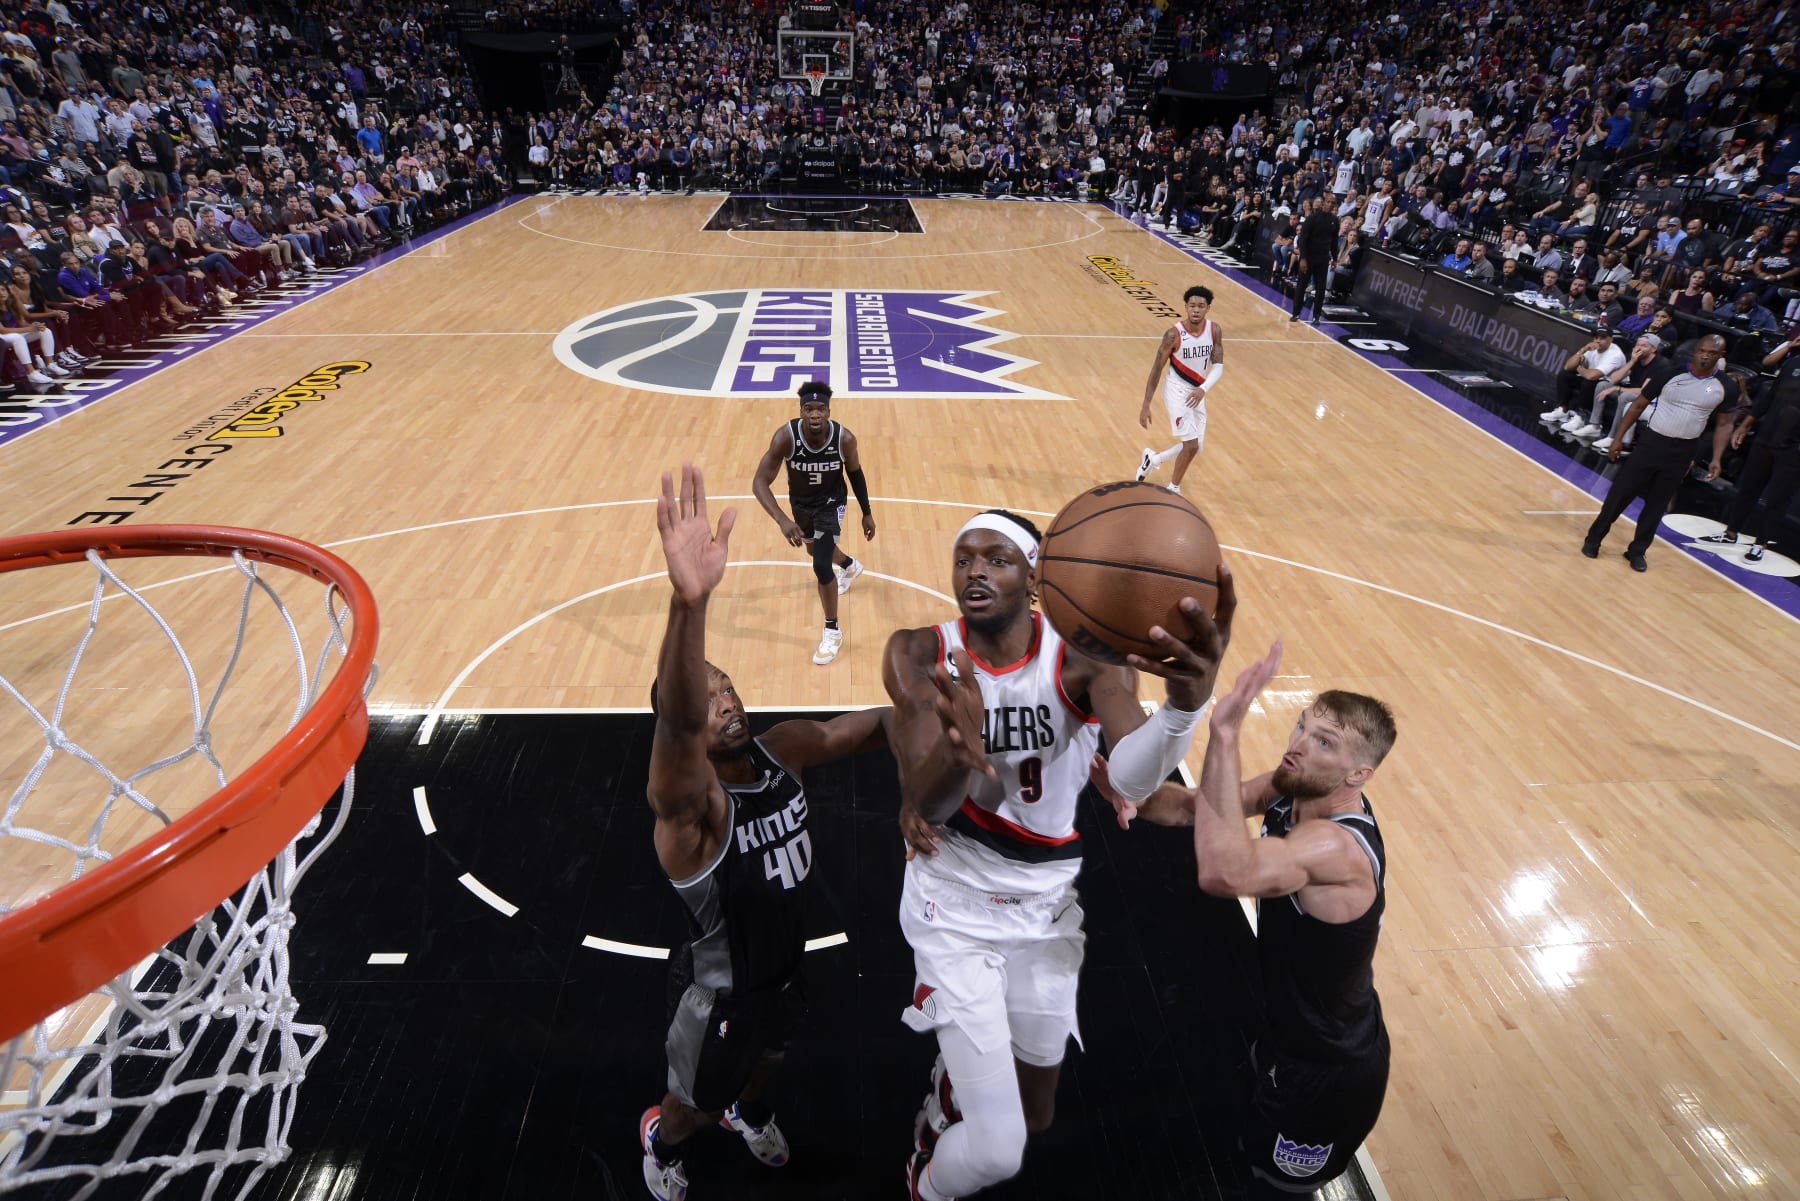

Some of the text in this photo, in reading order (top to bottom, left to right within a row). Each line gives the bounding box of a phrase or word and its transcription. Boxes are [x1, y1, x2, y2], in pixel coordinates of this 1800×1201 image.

[1121, 286, 1182, 317] CENTER
[1369, 269, 1429, 312] TRY FREE
[730, 291, 833, 392] KINGS
[855, 293, 899, 388] SACRAMENTO
[1449, 303, 1568, 375] DIALPAD.COM
[1203, 358, 1209, 370] 1
[172, 387, 277, 441] Credit Union
[790, 460, 841, 472] KINGS
[808, 472, 823, 486] 3
[1018, 756, 1043, 804] 9
[735, 789, 809, 854] KINGS
[763, 829, 812, 890] 40
[1275, 1149, 1327, 1166] KINGS
